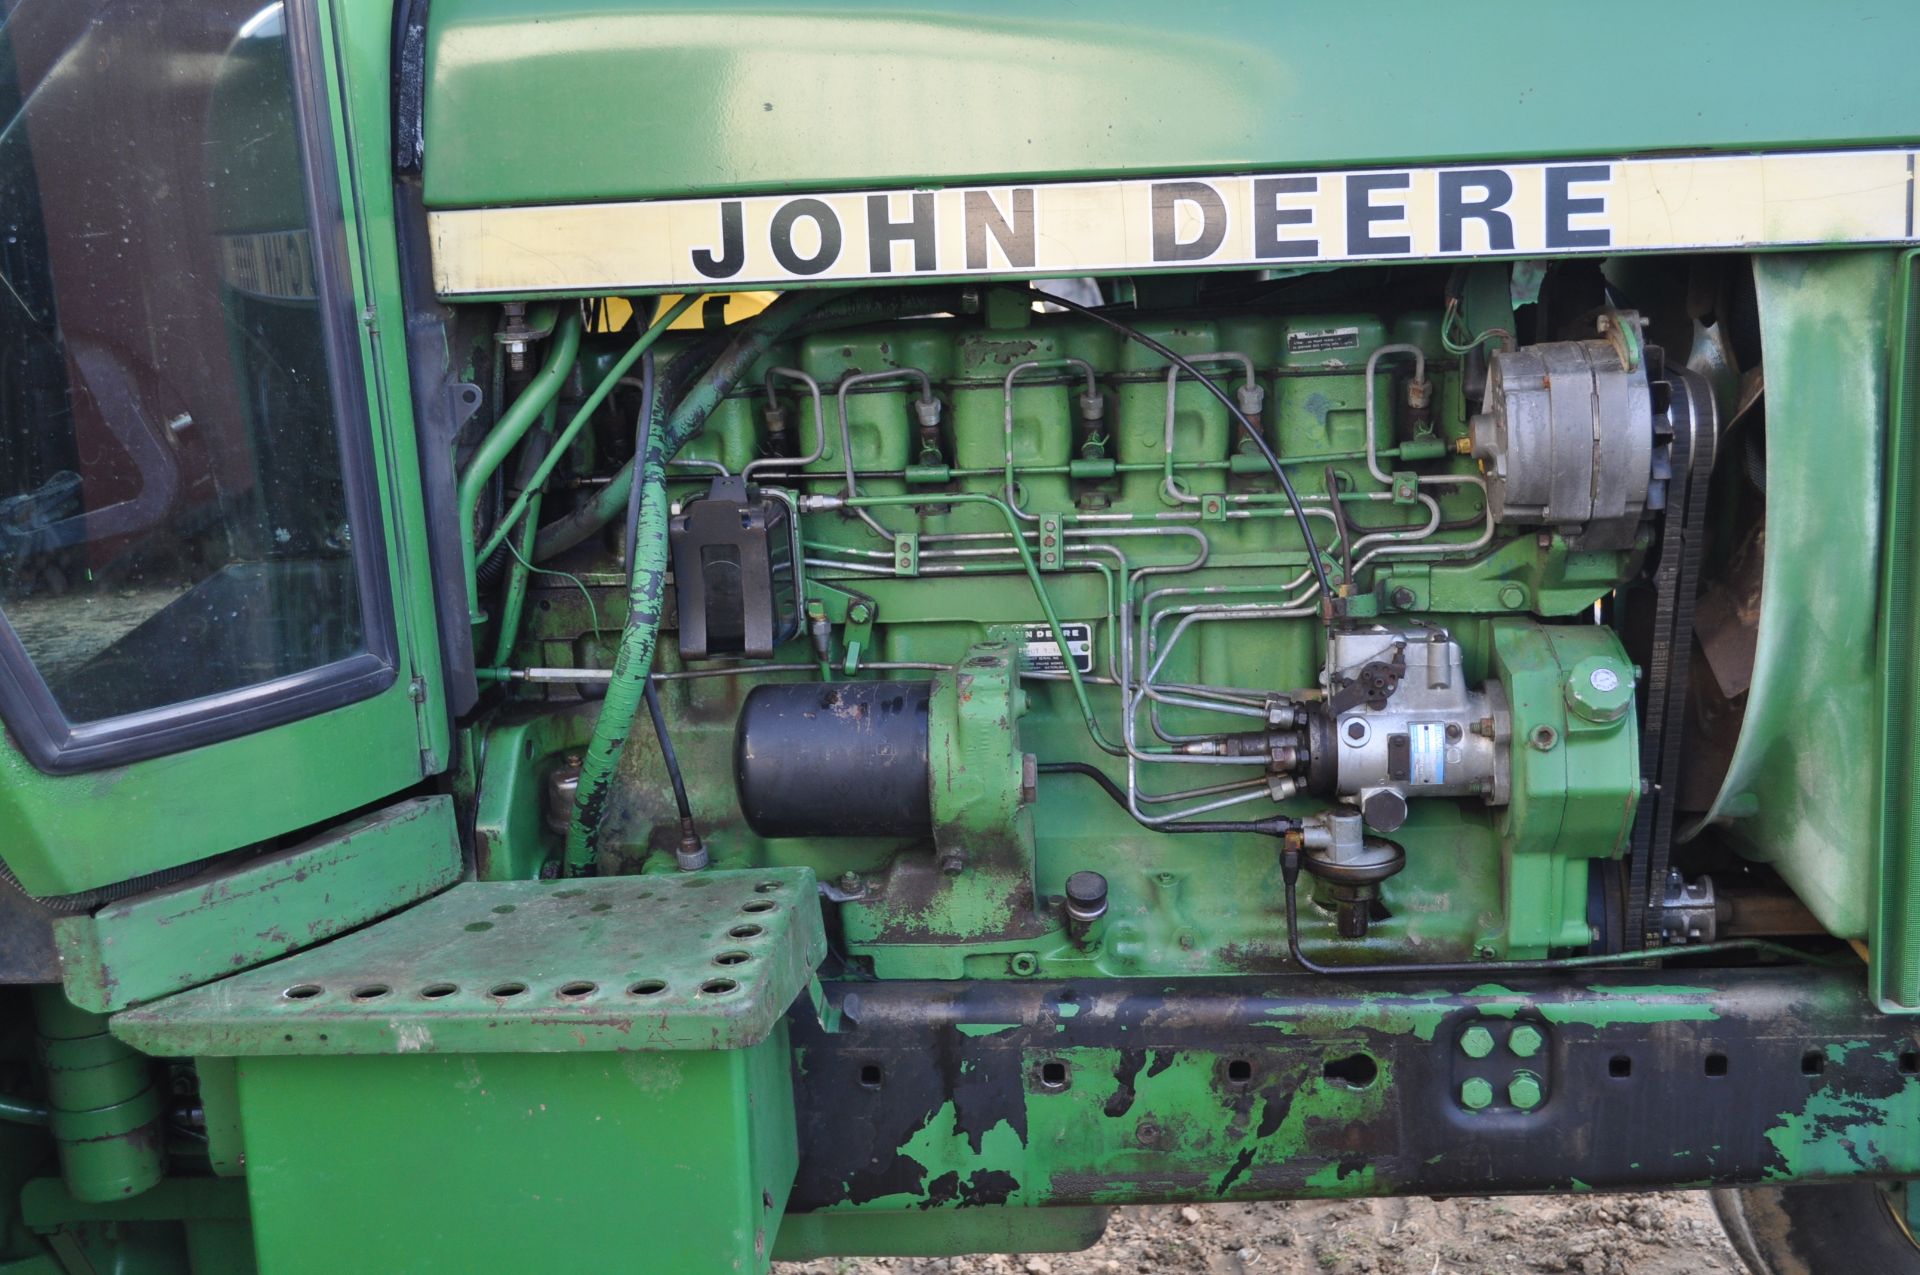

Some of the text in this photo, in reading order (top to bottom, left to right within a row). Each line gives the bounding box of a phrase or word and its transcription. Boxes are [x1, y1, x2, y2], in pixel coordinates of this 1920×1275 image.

[691, 165, 1611, 279] JOHN DEERE
[1036, 629, 1080, 638] DERE
